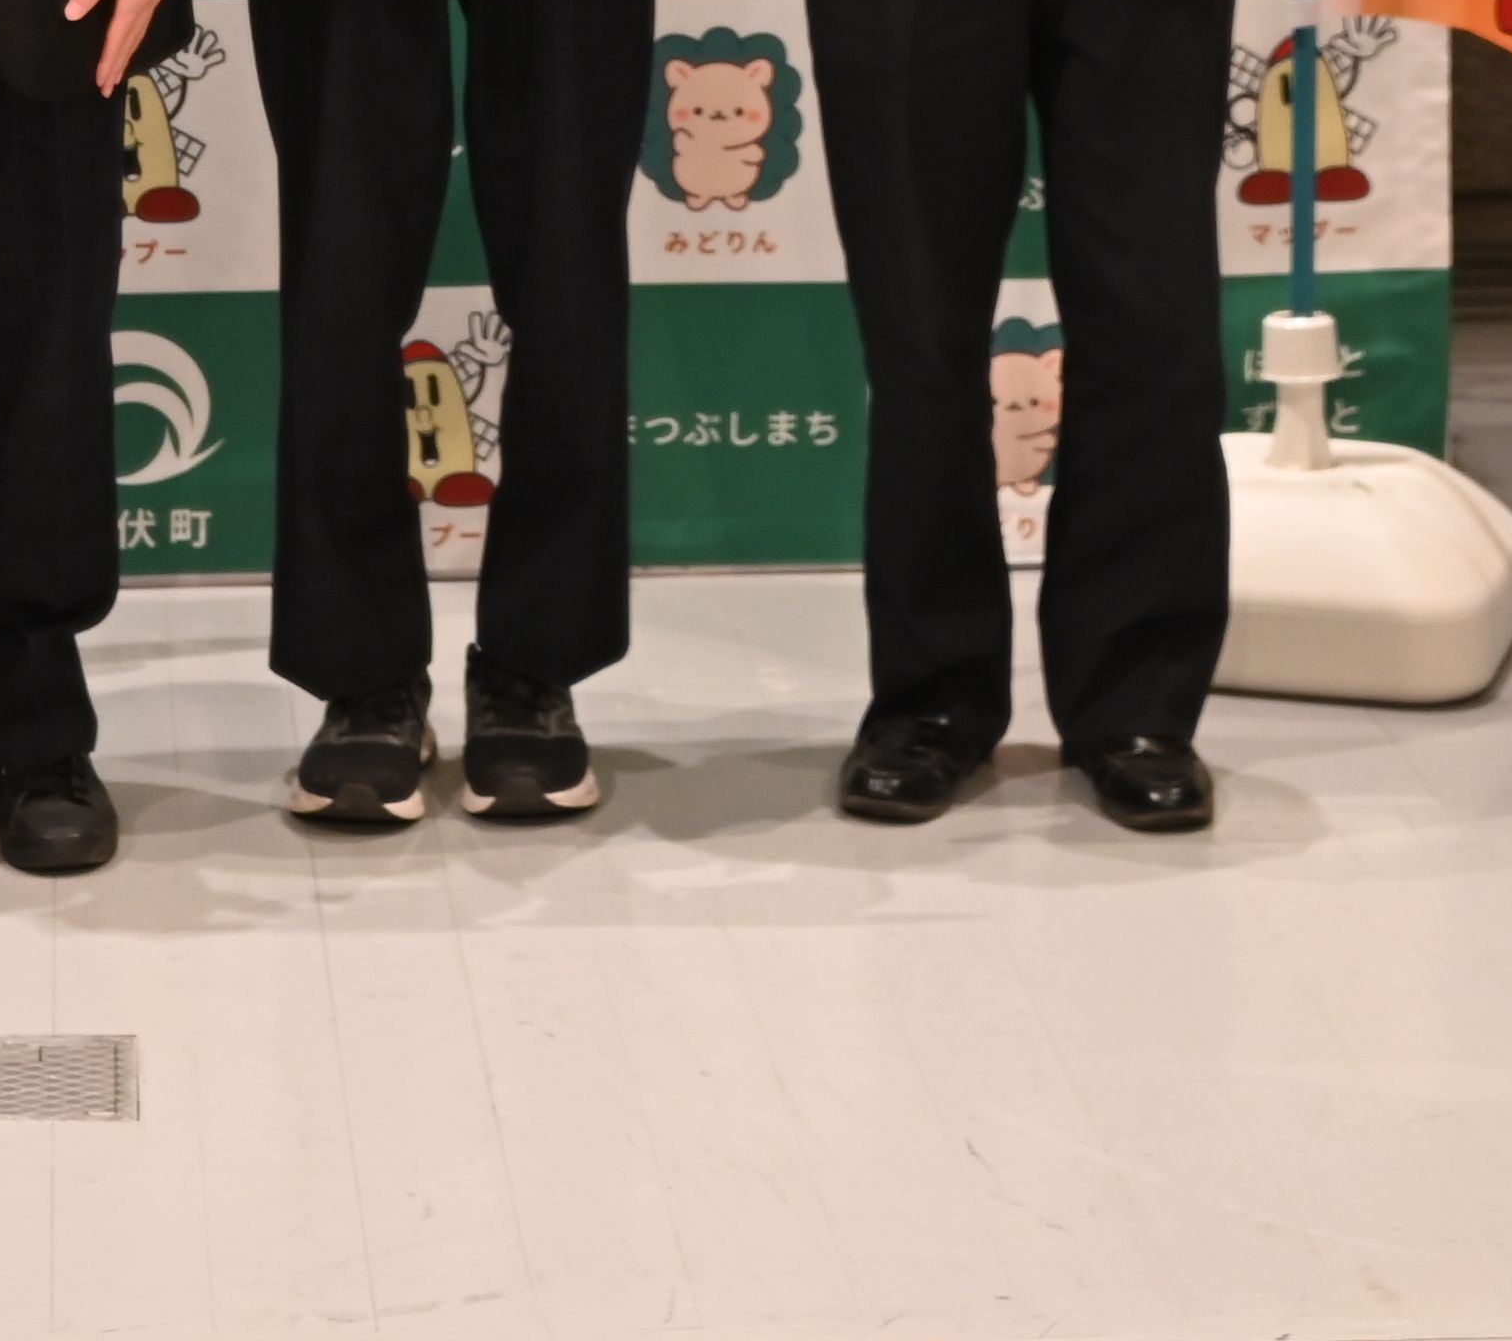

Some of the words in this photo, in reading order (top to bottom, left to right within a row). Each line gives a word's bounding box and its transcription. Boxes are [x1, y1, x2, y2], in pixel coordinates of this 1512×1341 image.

[663, 229, 776, 256] みどりん
[119, 507, 213, 550] 伏町
